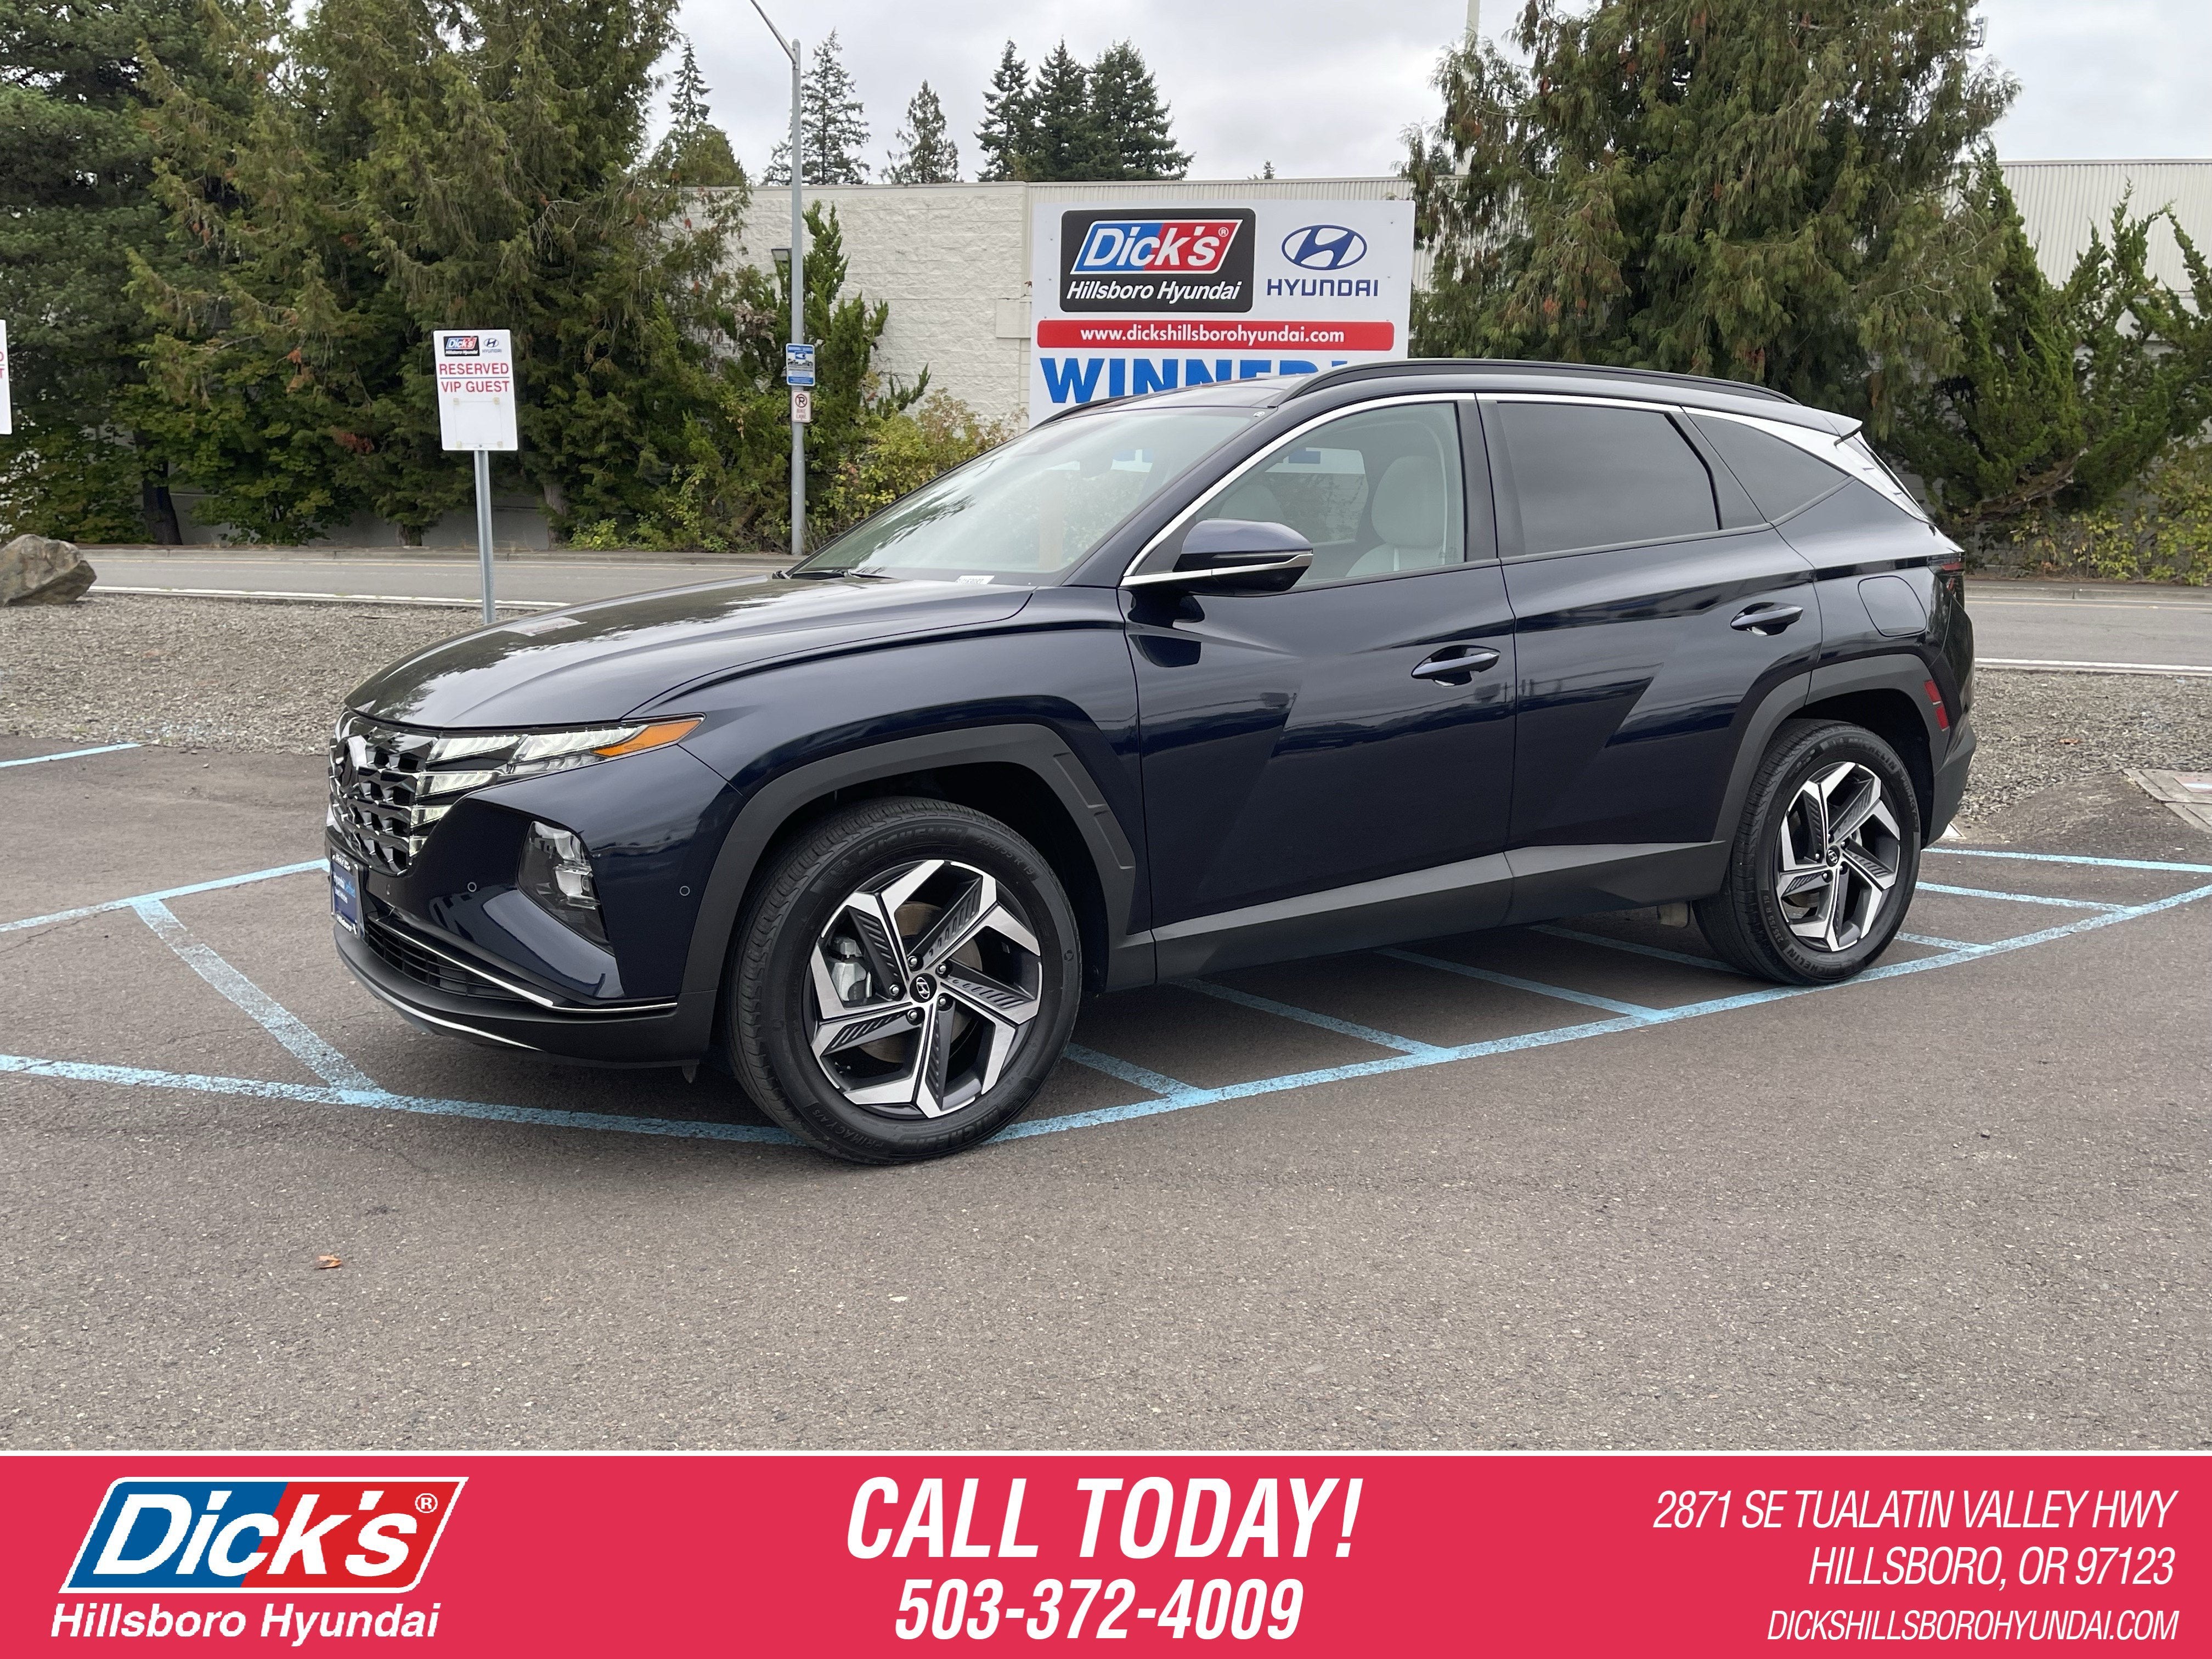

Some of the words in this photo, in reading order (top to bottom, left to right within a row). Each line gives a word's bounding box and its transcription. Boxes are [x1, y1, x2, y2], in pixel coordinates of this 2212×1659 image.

[1082, 227, 1220, 267] Dick's
[1066, 281, 1153, 300] Hillsboro
[1156, 281, 1242, 304] Hyundai
[1267, 279, 1378, 297] HYUNDAI
[1081, 325, 1345, 346] www.dickshillsborohyundai.com
[439, 363, 509, 375] RESERVED
[441, 381, 461, 392] VIP
[466, 381, 510, 392] GUEST
[826, 1121, 884, 1151] PRIMACY
